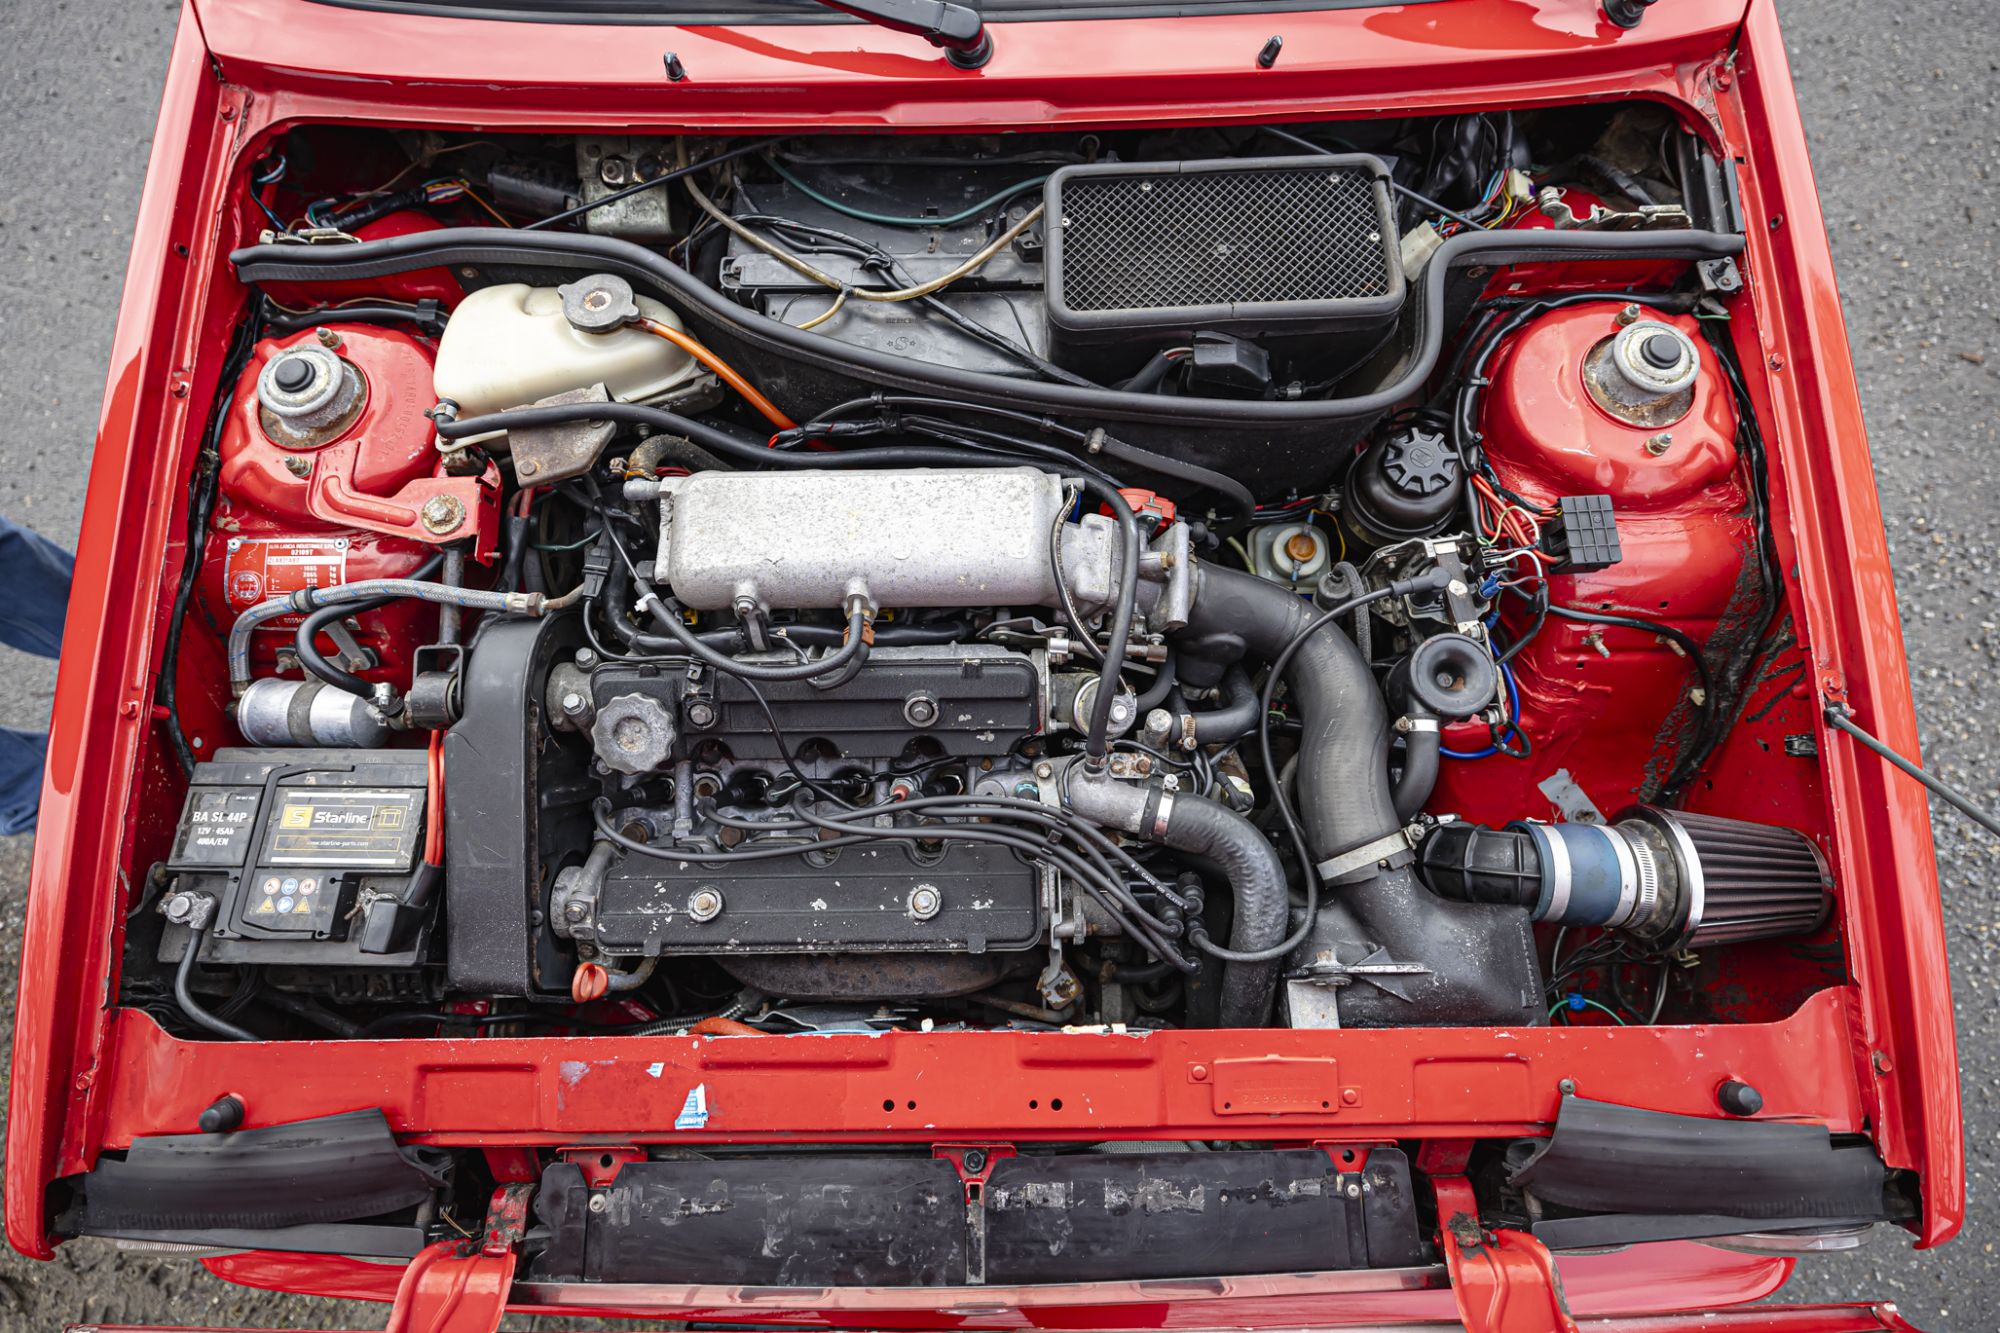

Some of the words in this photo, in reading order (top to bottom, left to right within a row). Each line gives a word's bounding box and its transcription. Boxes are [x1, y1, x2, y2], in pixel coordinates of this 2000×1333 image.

[192, 811, 209, 822] BA
[211, 811, 225, 823] SL
[227, 812, 247, 823] 44P
[313, 811, 368, 824] Starline
[197, 827, 211, 835] 12V
